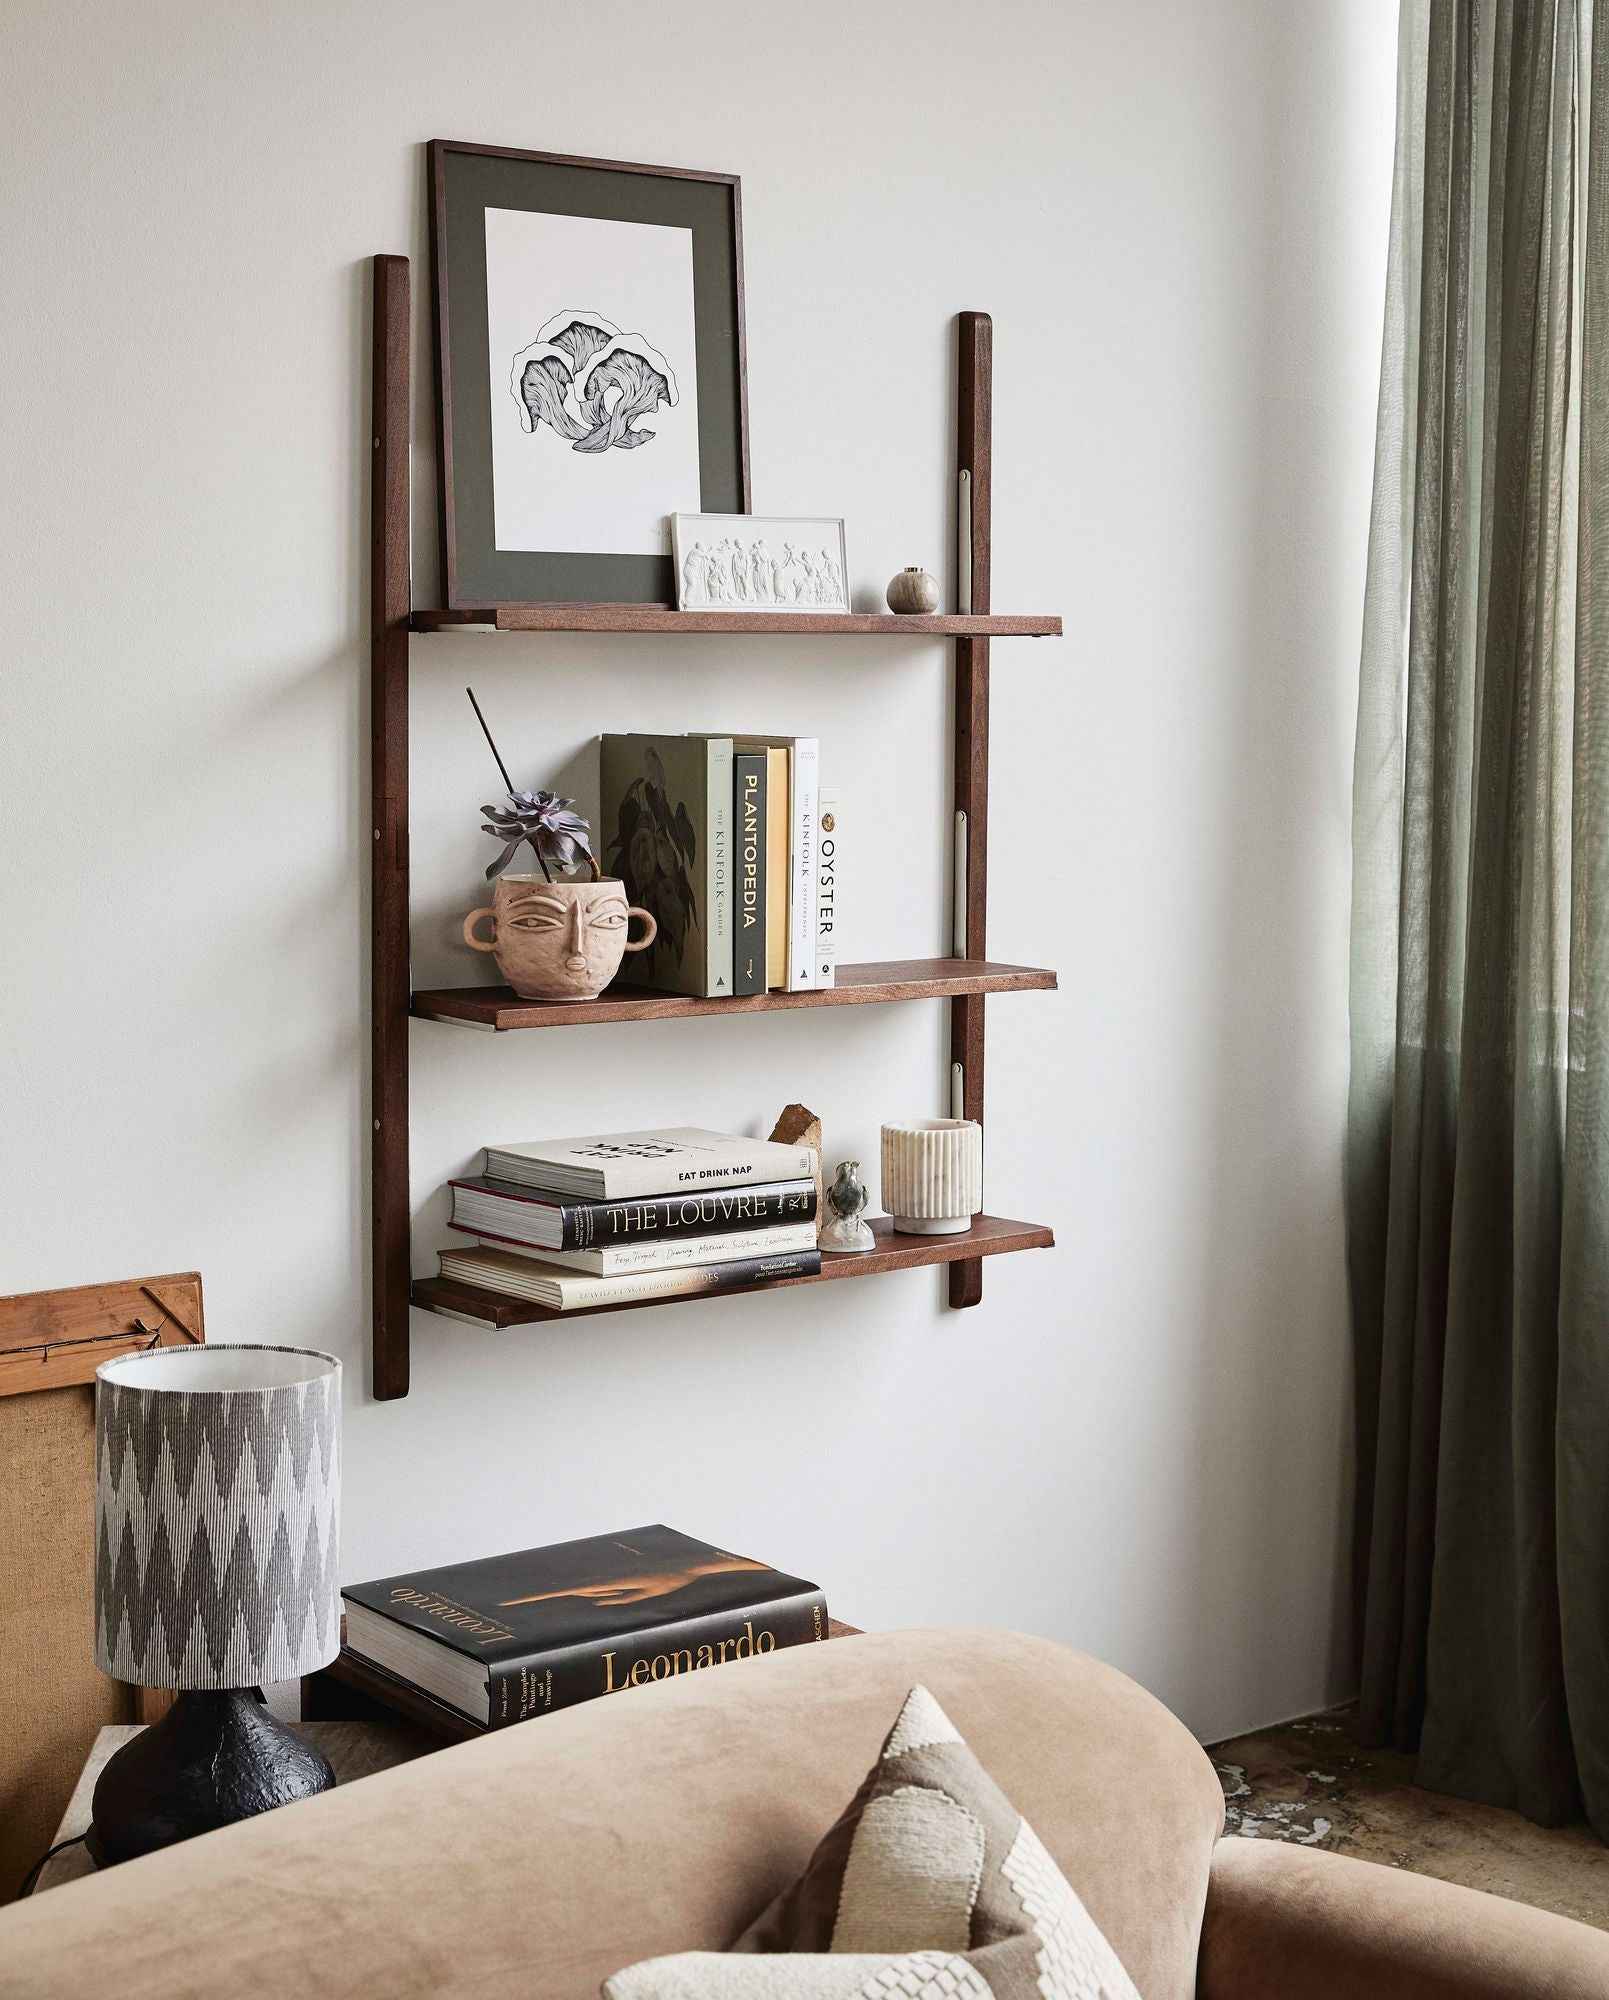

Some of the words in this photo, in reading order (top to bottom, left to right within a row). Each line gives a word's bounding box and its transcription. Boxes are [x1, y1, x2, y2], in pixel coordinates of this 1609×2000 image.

[715, 831, 725, 898] KINFOLK
[743, 774, 758, 929] PLANTOPEDIA
[801, 814, 810, 877] KINFOLK
[819, 839, 835, 936] OYSTER
[678, 1171, 697, 1181] EAT
[699, 1167, 730, 1179] DRINK
[732, 1165, 753, 1175] NAP
[606, 1204, 658, 1234] THE
[664, 1192, 768, 1228] LOUVRE
[390, 1587, 514, 1645] Leonardo
[813, 1605, 822, 1642] ASCHEN
[520, 1666, 529, 1703] Complete
[601, 1620, 776, 1694] Leonardo
[519, 1704, 527, 1719] The
